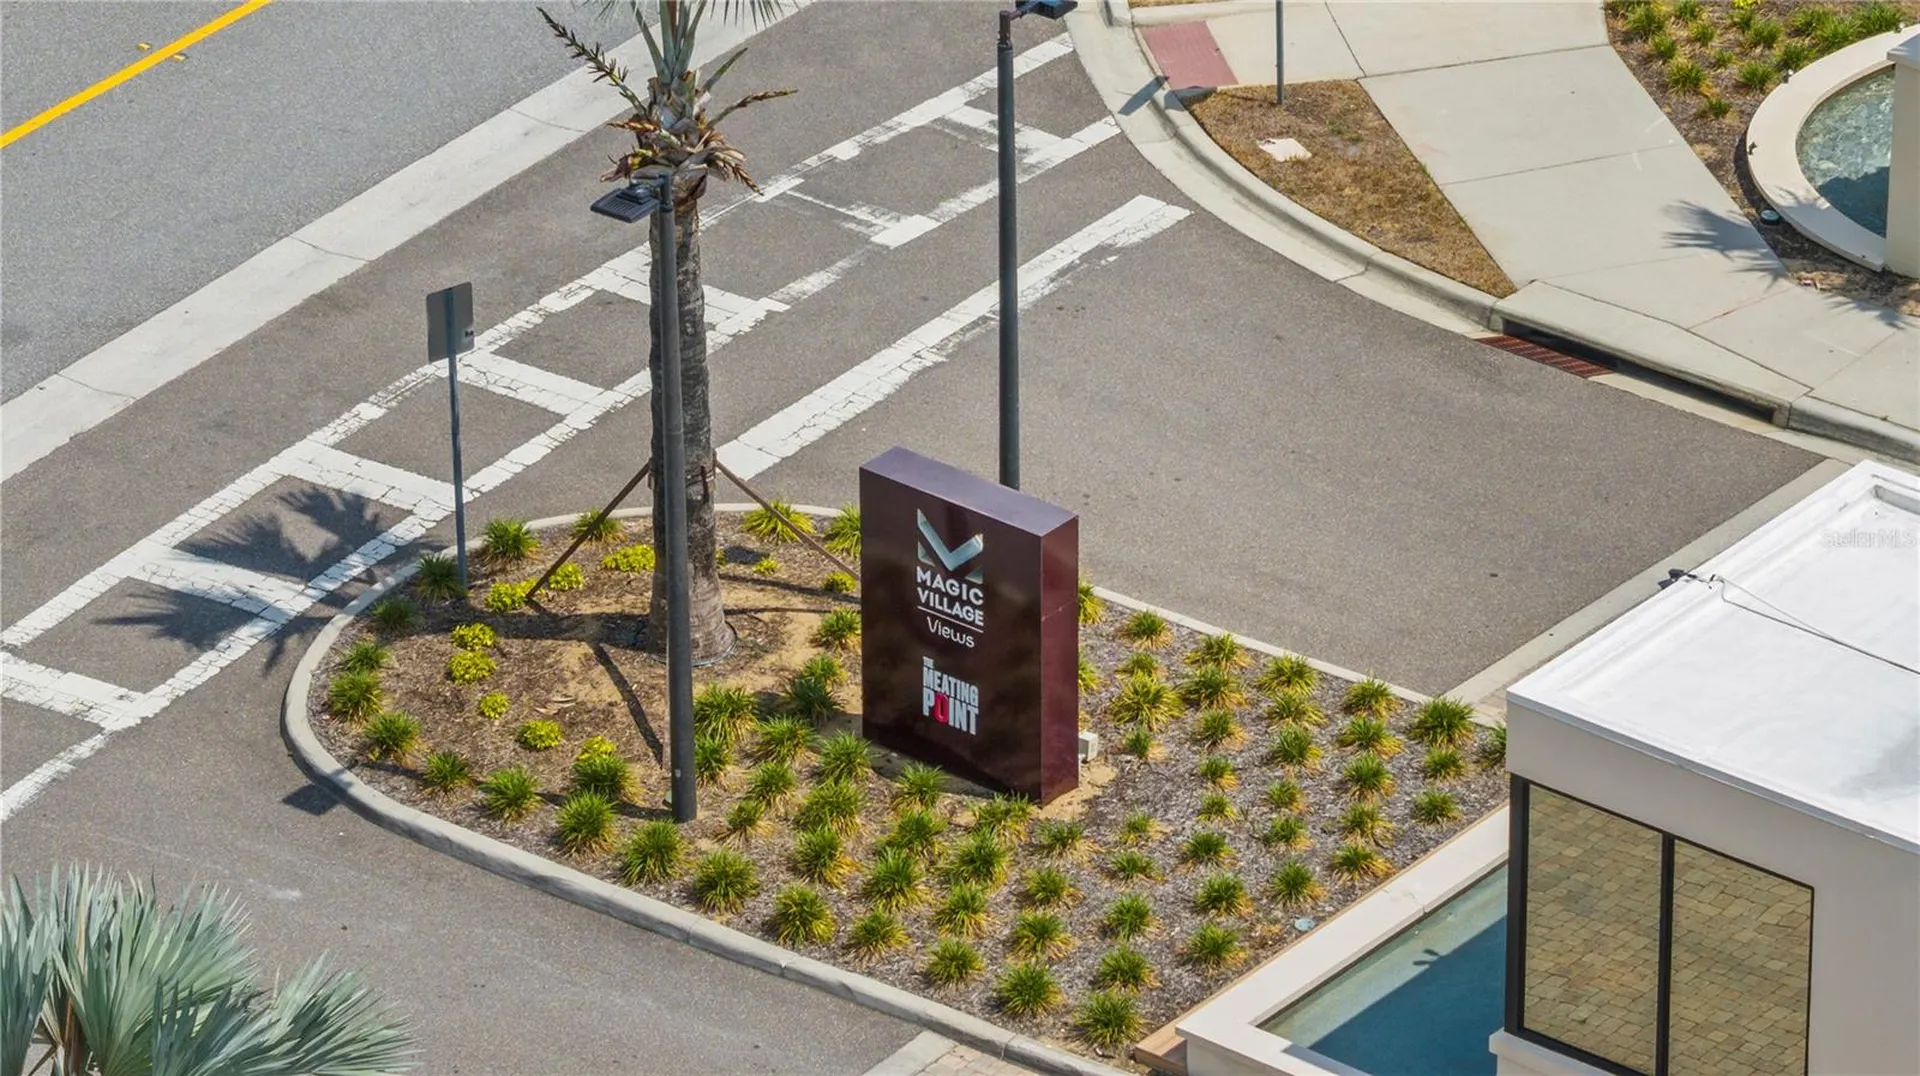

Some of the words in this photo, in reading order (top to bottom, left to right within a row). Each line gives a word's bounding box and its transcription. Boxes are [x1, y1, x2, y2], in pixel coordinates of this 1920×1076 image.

[916, 566, 984, 605] MAGIC
[917, 587, 984, 627] VILLAGE
[927, 616, 975, 648] Views
[923, 666, 979, 708] MEATING
[923, 687, 979, 735] POINT
